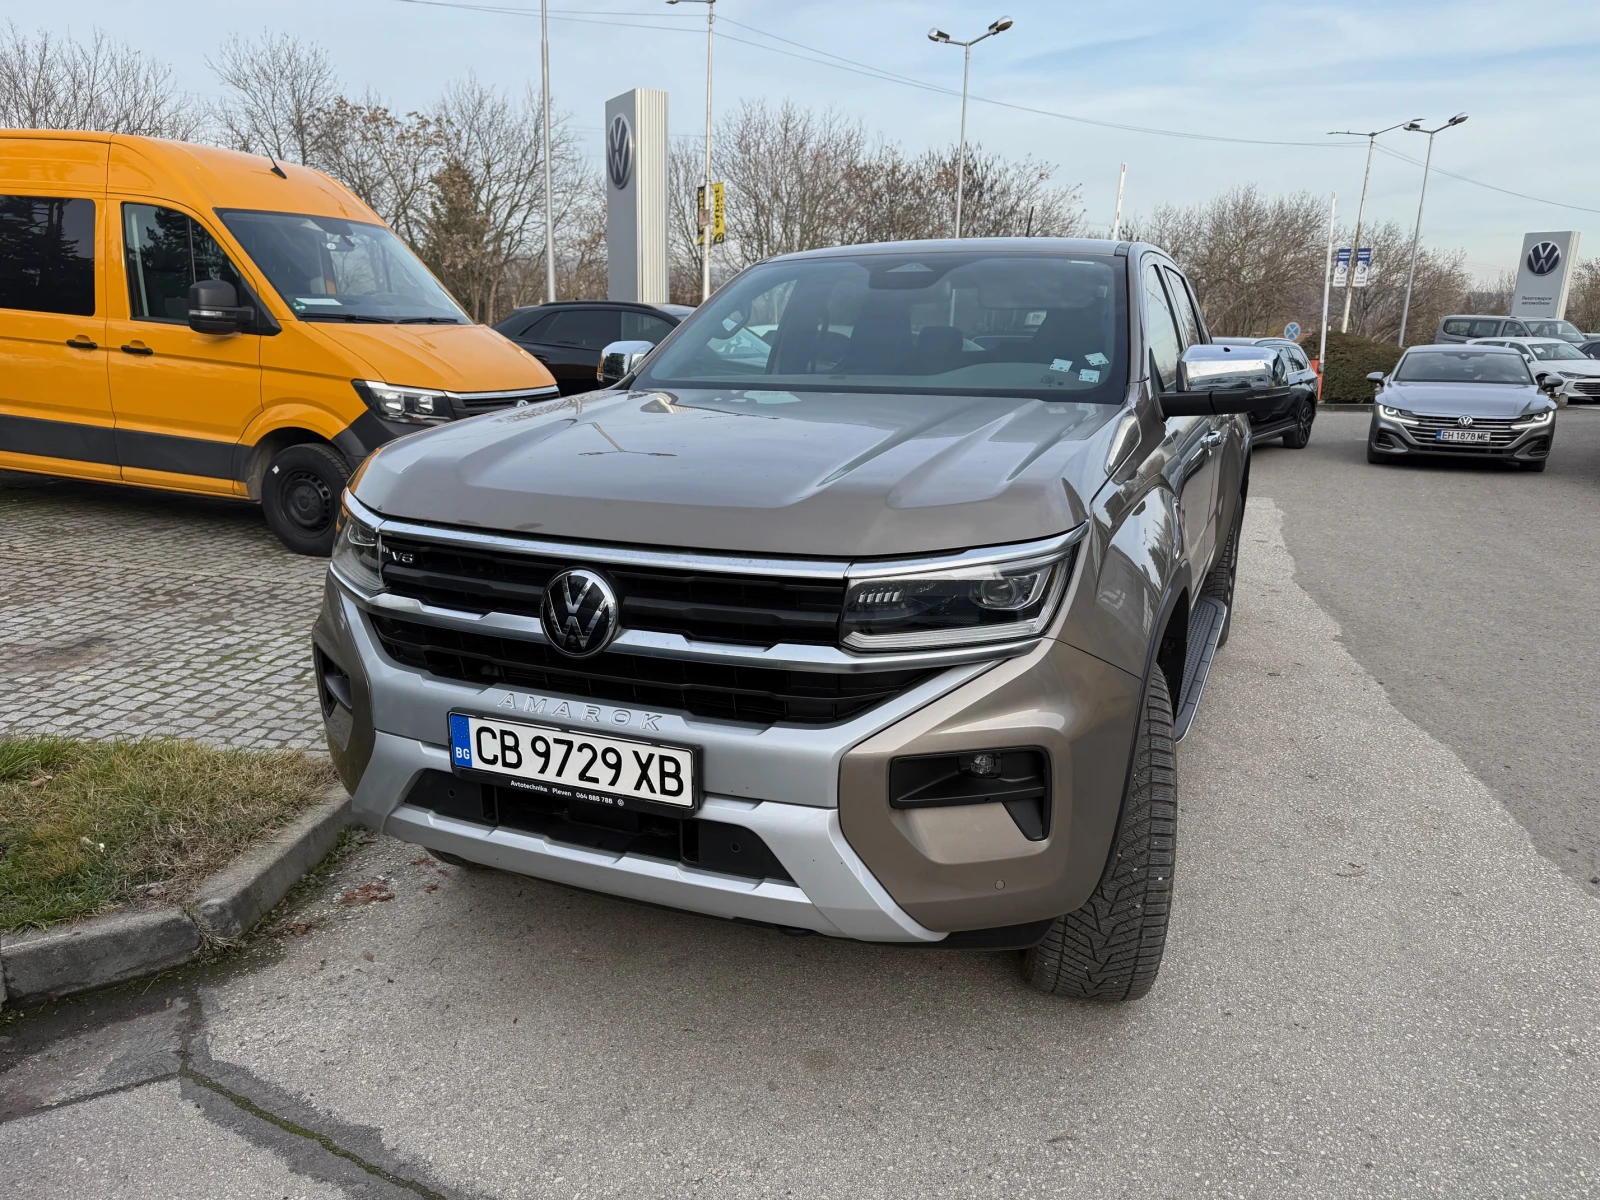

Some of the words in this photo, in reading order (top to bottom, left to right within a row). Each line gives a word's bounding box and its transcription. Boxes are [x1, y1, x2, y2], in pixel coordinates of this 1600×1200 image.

[1442, 431, 1454, 440] EH
[1456, 432, 1476, 440] 1878
[1477, 432, 1489, 441] ME
[391, 551, 413, 563] V6
[542, 569, 615, 655] VW
[497, 692, 663, 731] AMAROK
[455, 746, 470, 760] BG
[476, 726, 523, 769] CB
[530, 735, 623, 787] 9729
[632, 750, 684, 797] XB
[552, 787, 572, 796] Pleven
